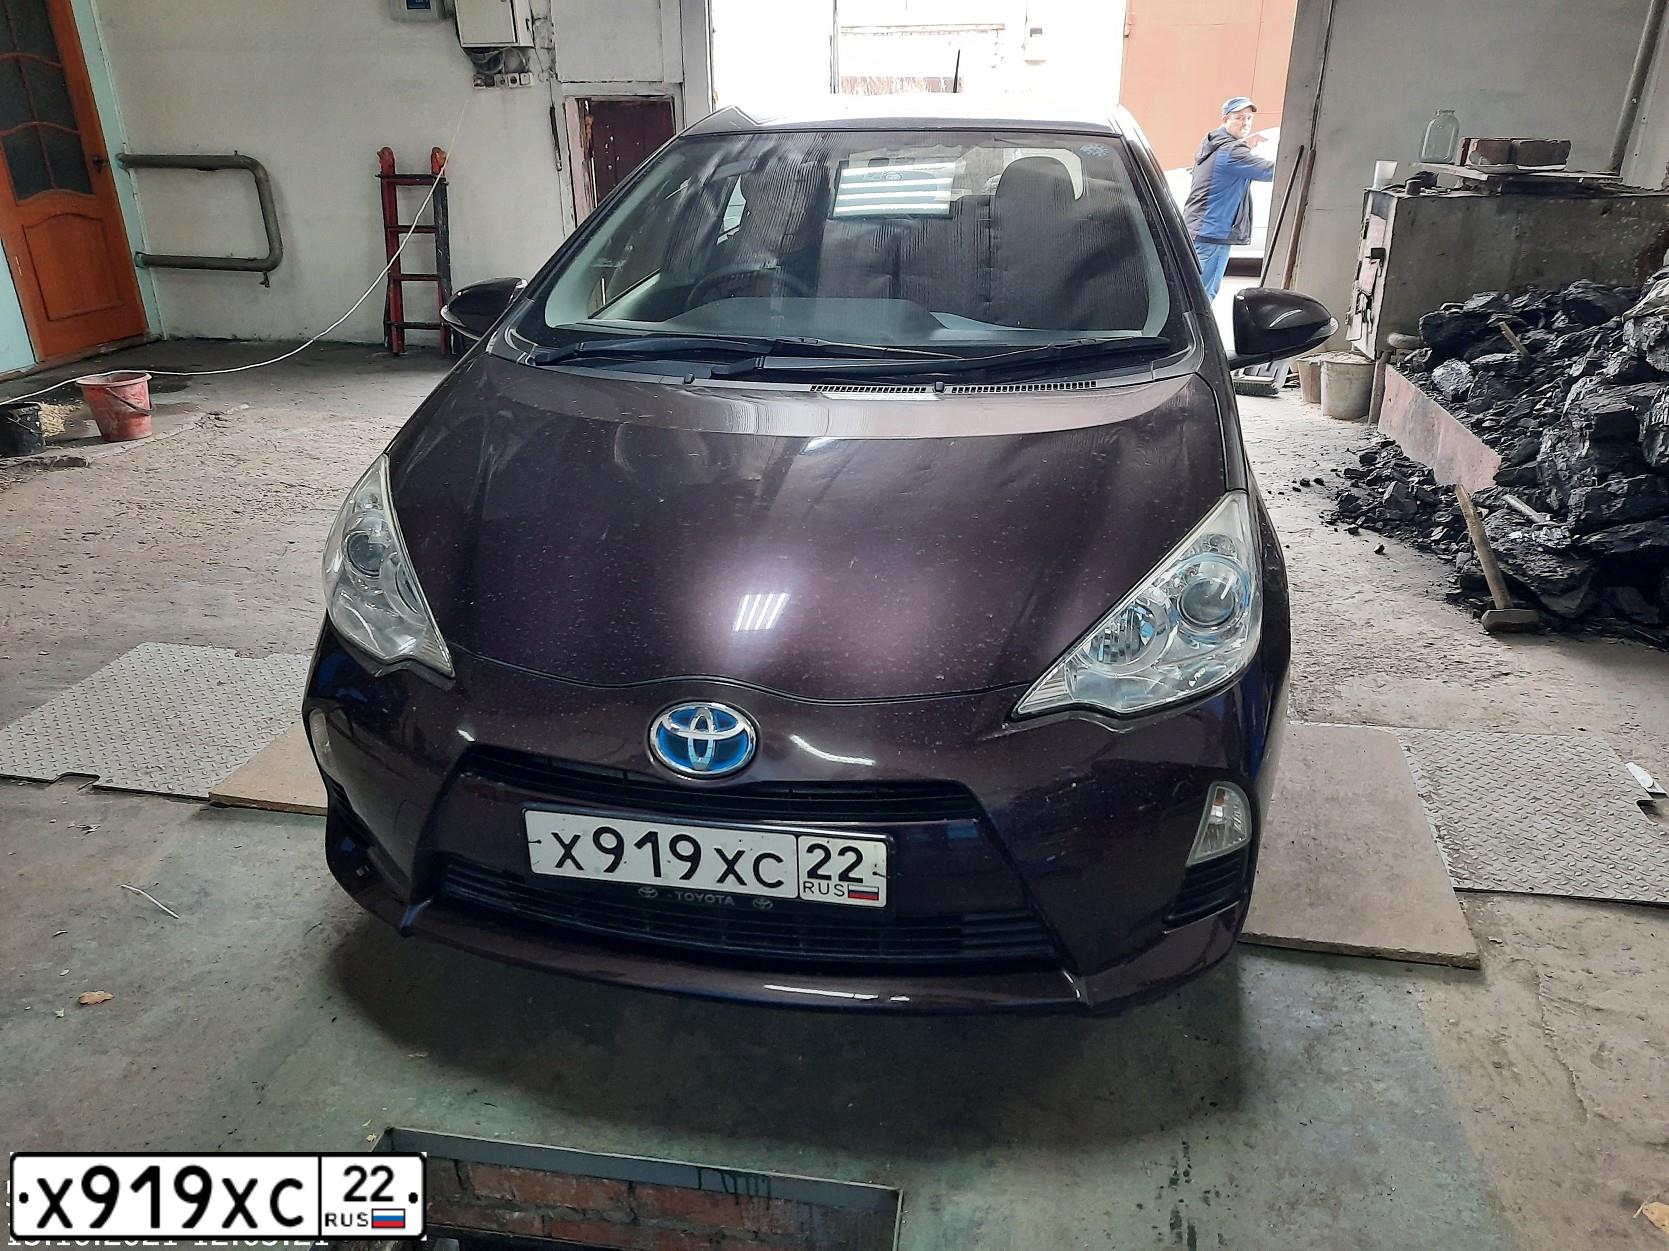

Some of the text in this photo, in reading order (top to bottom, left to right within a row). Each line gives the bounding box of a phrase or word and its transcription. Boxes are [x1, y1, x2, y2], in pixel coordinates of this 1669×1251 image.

[805, 843, 864, 883] 22
[803, 881, 844, 897] RUS
[675, 890, 736, 906] TOYOTA
